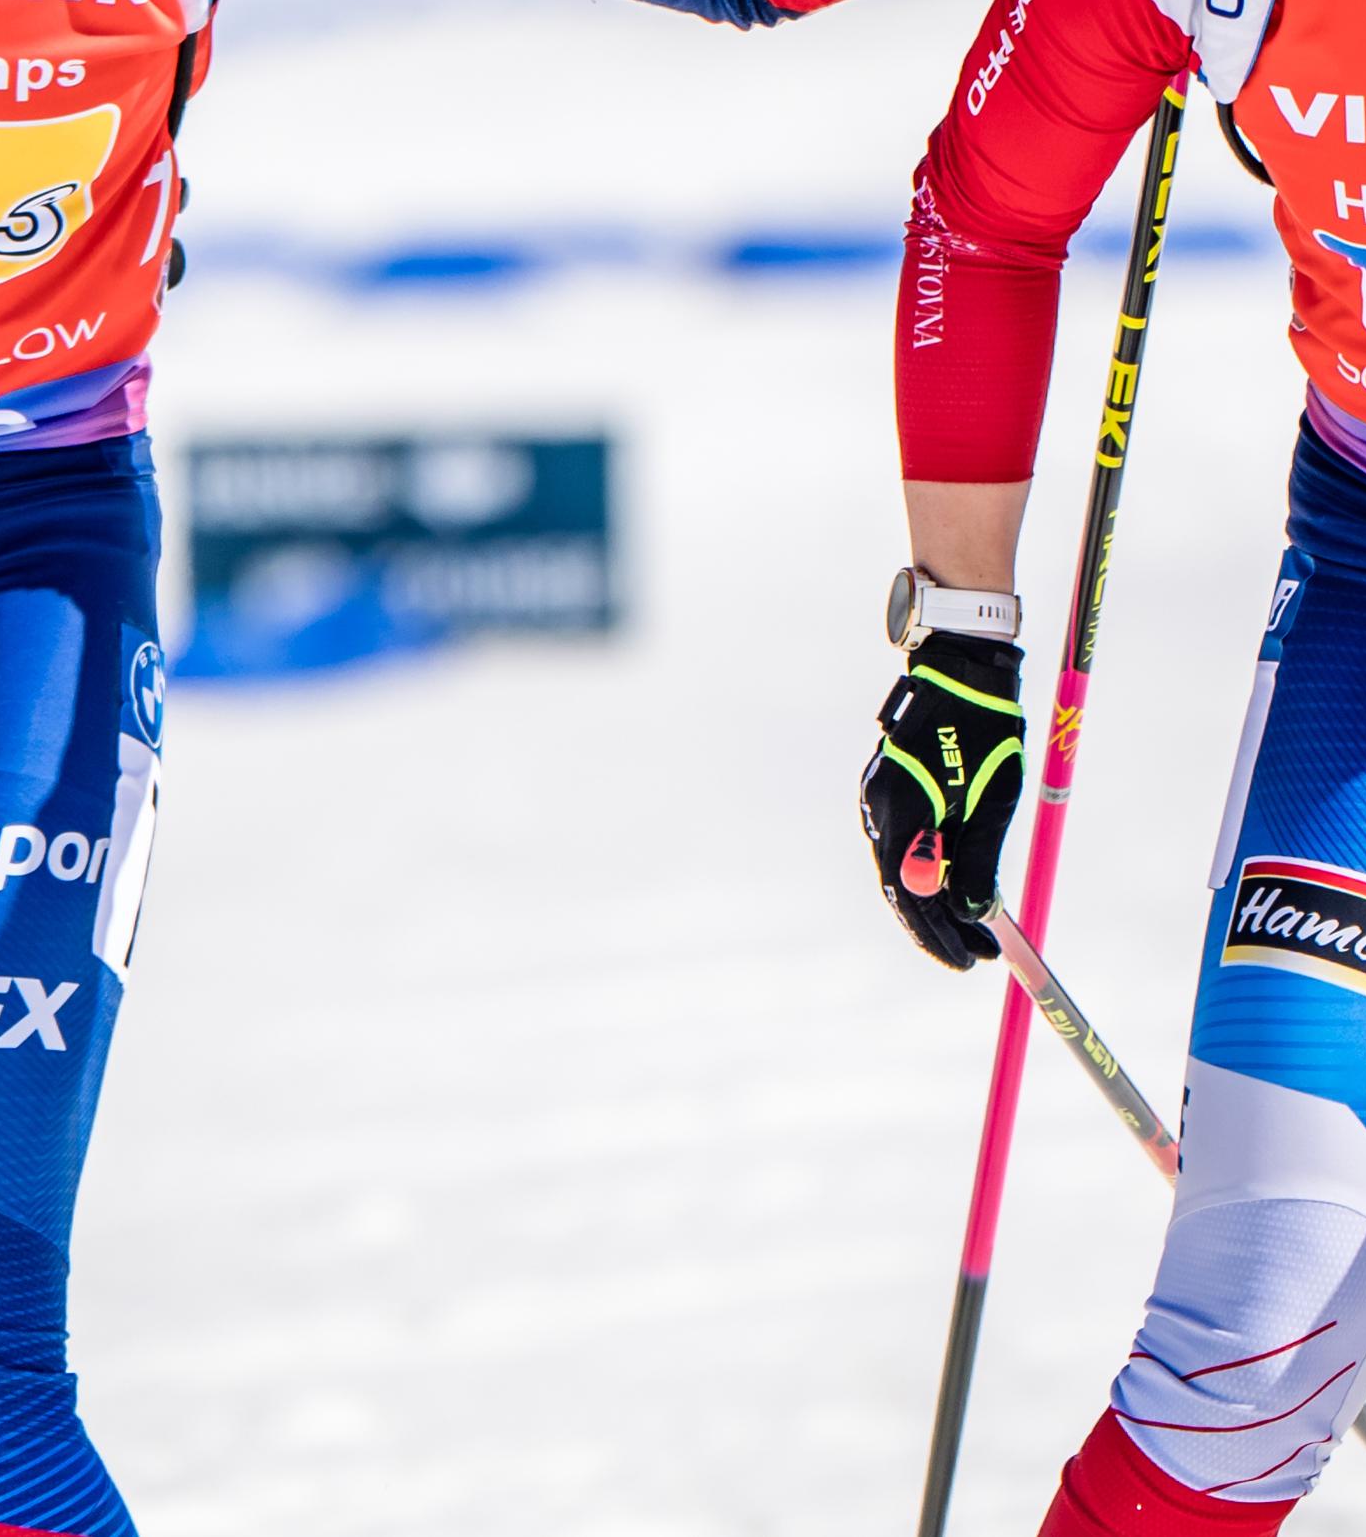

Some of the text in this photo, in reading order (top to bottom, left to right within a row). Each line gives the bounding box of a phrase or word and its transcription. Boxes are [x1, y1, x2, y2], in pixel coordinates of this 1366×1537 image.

[966, 28, 1015, 116] PRO
[1093, 311, 1149, 470] LEKI
[937, 726, 965, 787] LEKI
